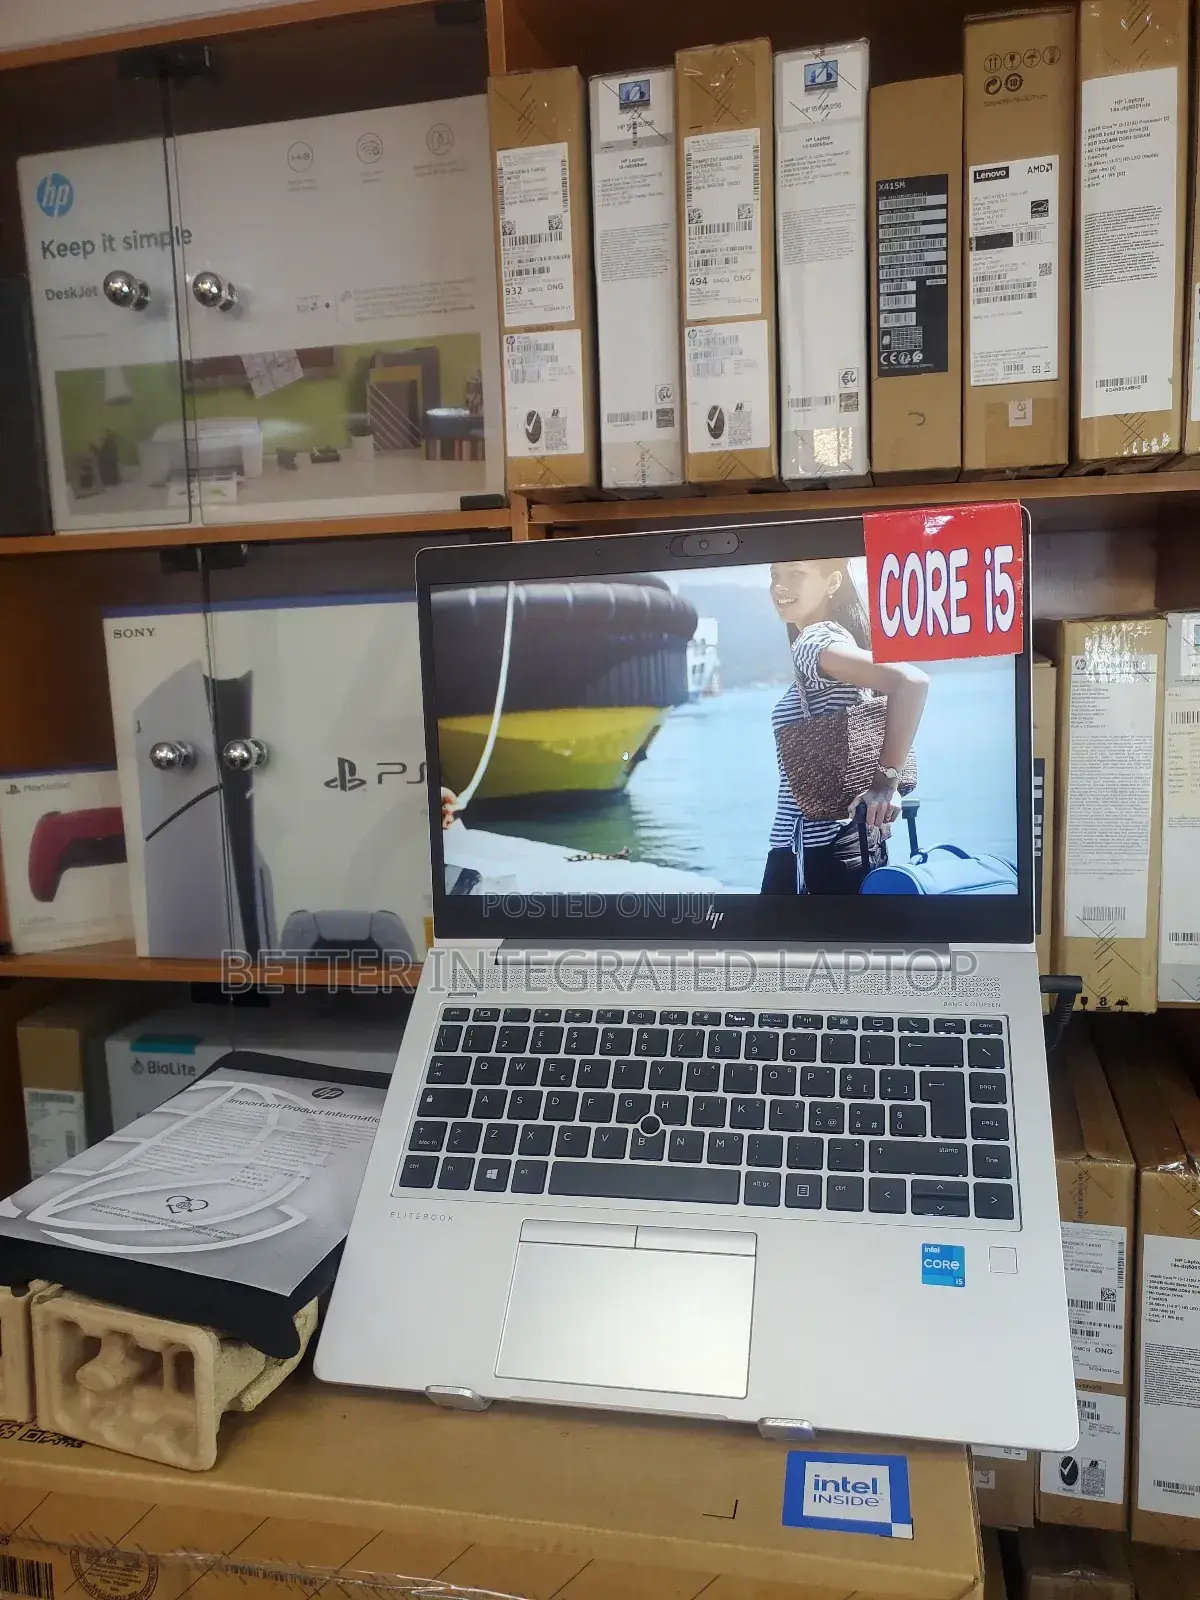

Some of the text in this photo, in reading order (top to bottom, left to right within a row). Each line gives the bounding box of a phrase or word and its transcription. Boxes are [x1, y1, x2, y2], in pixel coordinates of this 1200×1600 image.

[976, 164, 1046, 180] Lenovo AMD
[879, 181, 906, 191] X415M
[40, 226, 192, 260] Keep it simple
[690, 276, 708, 286] 494
[45, 285, 98, 301] DeskJet
[505, 286, 522, 295] 932
[879, 544, 1016, 638] CORE i5
[112, 628, 156, 640] SONY
[705, 904, 724, 929] hp
[147, 1060, 196, 1076] BioLite
[228, 1098, 282, 1110] Important
[282, 1104, 325, 1116] Product
[661, 1101, 669, 1109] H
[776, 1106, 783, 1115] L
[527, 1131, 534, 1139] X
[563, 1132, 572, 1141] C
[602, 1134, 609, 1142] V
[676, 1137, 685, 1145] N
[715, 1139, 725, 1148] M
[390, 1211, 454, 1222] ELITEBOOK
[1094, 1346, 1113, 1355] ONG
[813, 1474, 878, 1495] intel
